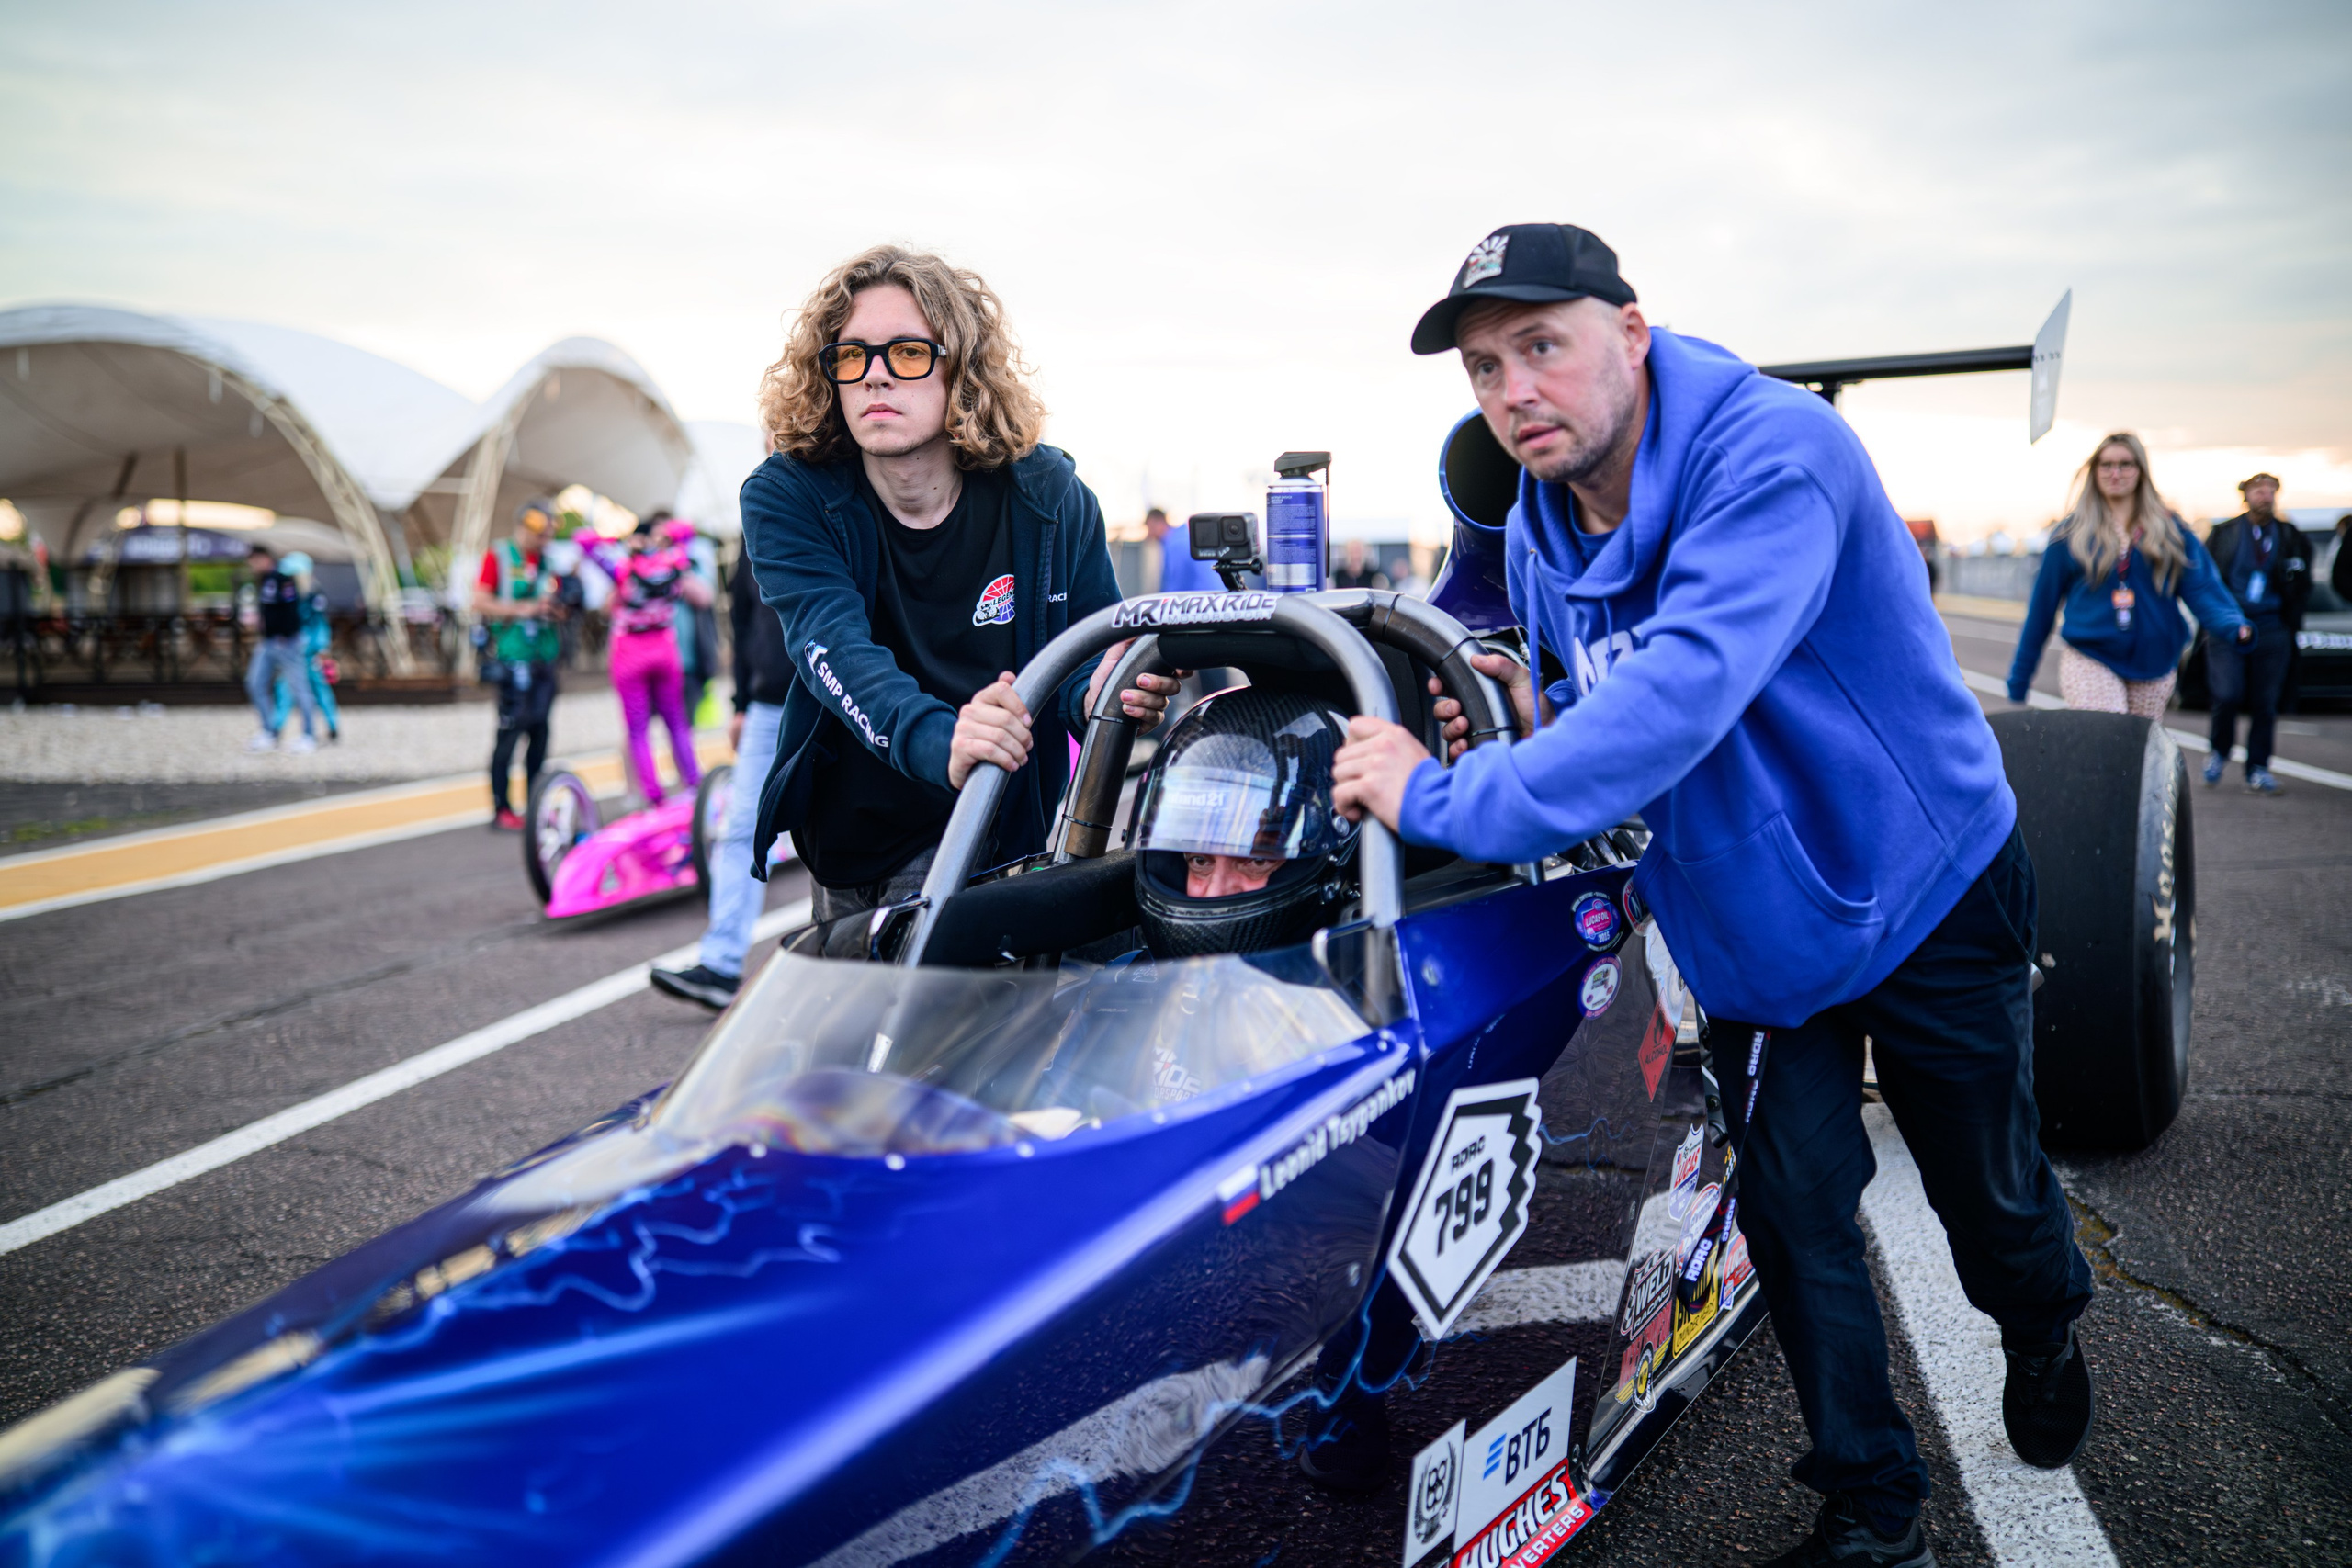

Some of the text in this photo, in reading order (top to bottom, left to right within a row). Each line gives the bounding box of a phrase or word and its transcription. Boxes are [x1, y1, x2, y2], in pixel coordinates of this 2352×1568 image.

[993, 589, 1014, 605] LEGEN
[1168, 611, 1273, 626] MOTORSPORT
[817, 661, 889, 748] SMP RACING
[1585, 912, 1601, 928] LUCAS
[1747, 1031, 1765, 1077] RDRC
[1259, 1068, 1416, 1201] Leonid Tsygankov
[1451, 1135, 1487, 1174] RDRC
[1434, 1157, 1494, 1258] 799
[1685, 1237, 1713, 1282] RDRC
[1633, 1284, 1670, 1330] RACING
[1635, 1253, 1672, 1316] WELD
[1505, 1406, 1553, 1486] ВТБ
